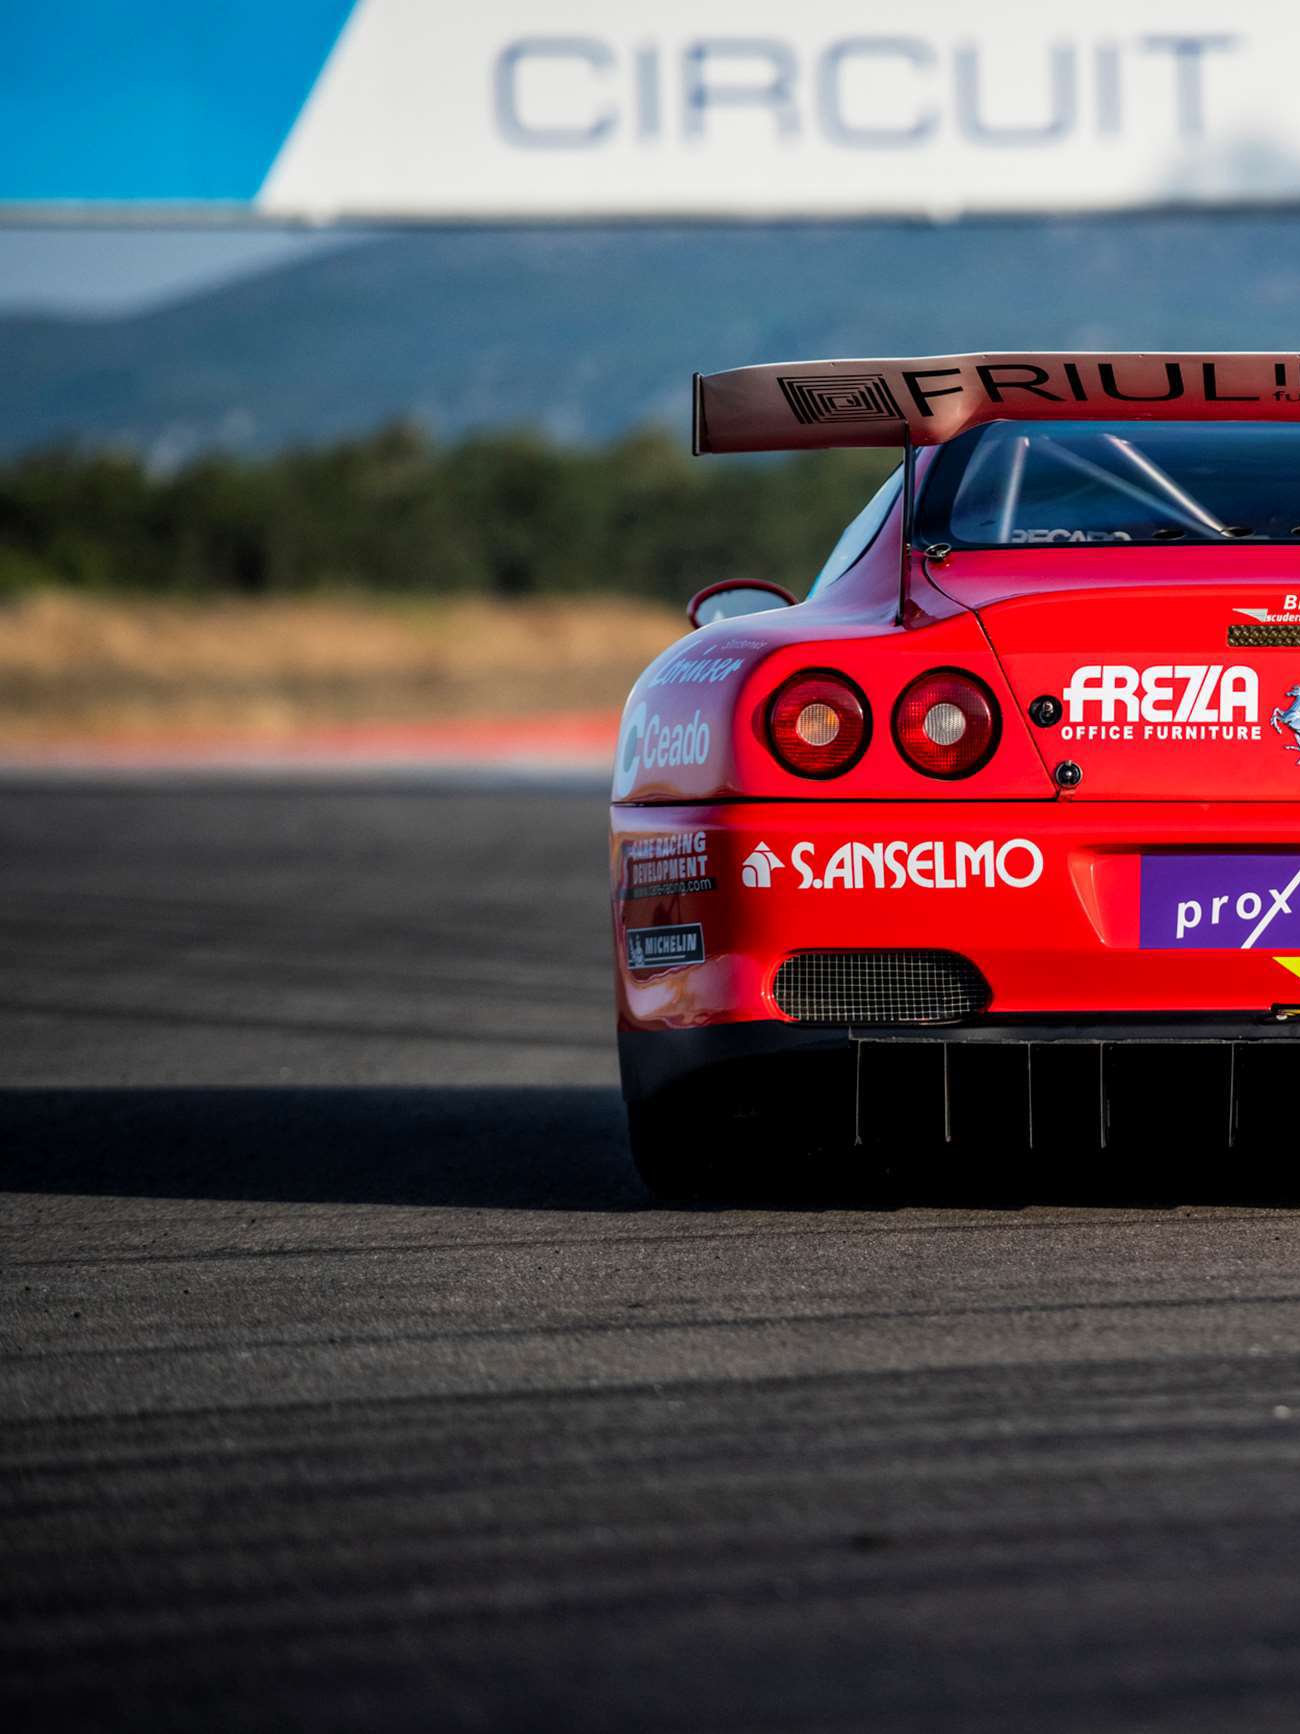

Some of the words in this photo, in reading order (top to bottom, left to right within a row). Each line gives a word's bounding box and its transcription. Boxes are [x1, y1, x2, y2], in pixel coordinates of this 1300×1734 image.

[492, 34, 1240, 150] CIRCUIT
[1061, 725, 1134, 740] OFFICE
[1144, 725, 1262, 740] FURNITURE
[633, 855, 708, 885] DEVELOPMENT
[790, 838, 1045, 889] S.ANSELMO
[644, 932, 698, 955] MICHELIN
